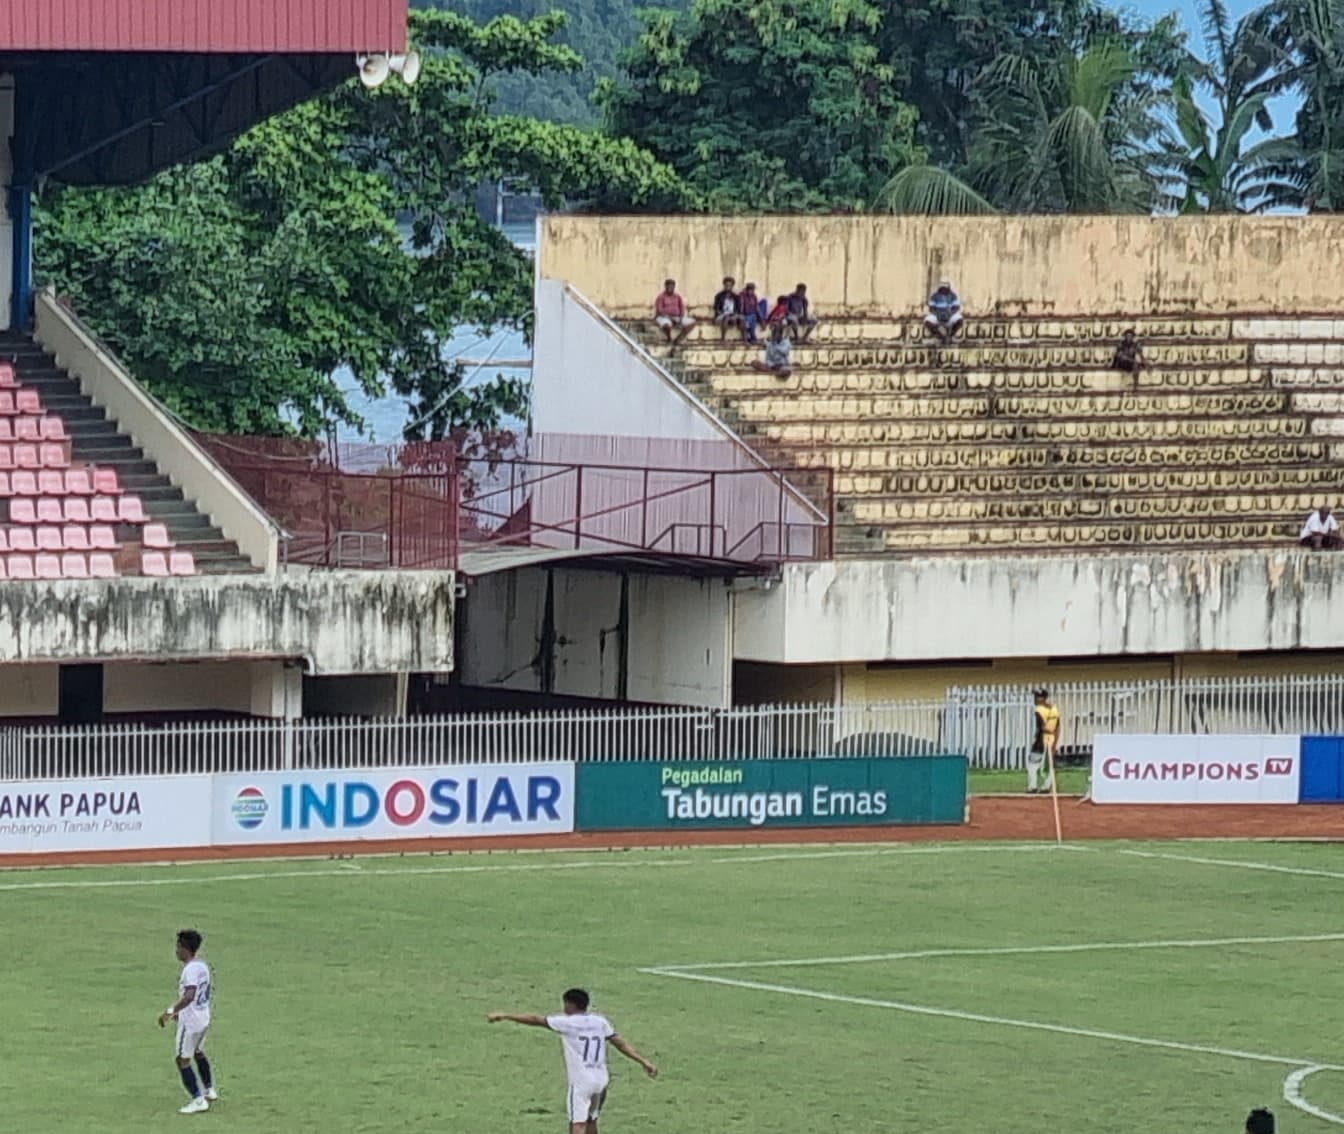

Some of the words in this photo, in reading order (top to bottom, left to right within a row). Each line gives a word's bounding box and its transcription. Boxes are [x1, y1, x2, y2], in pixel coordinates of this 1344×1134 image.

[662, 767, 743, 785] Pegadaian
[1102, 758, 1259, 781] CHAMPIONS
[1269, 761, 1289, 773] TV
[60, 791, 141, 816] PAPUA
[280, 776, 562, 830] INDOSIAR
[661, 787, 802, 825] Tabungan
[813, 786, 888, 817] Emas
[63, 820, 98, 834] Tanah
[102, 818, 142, 833] Papua
[578, 1035, 602, 1063] 77
